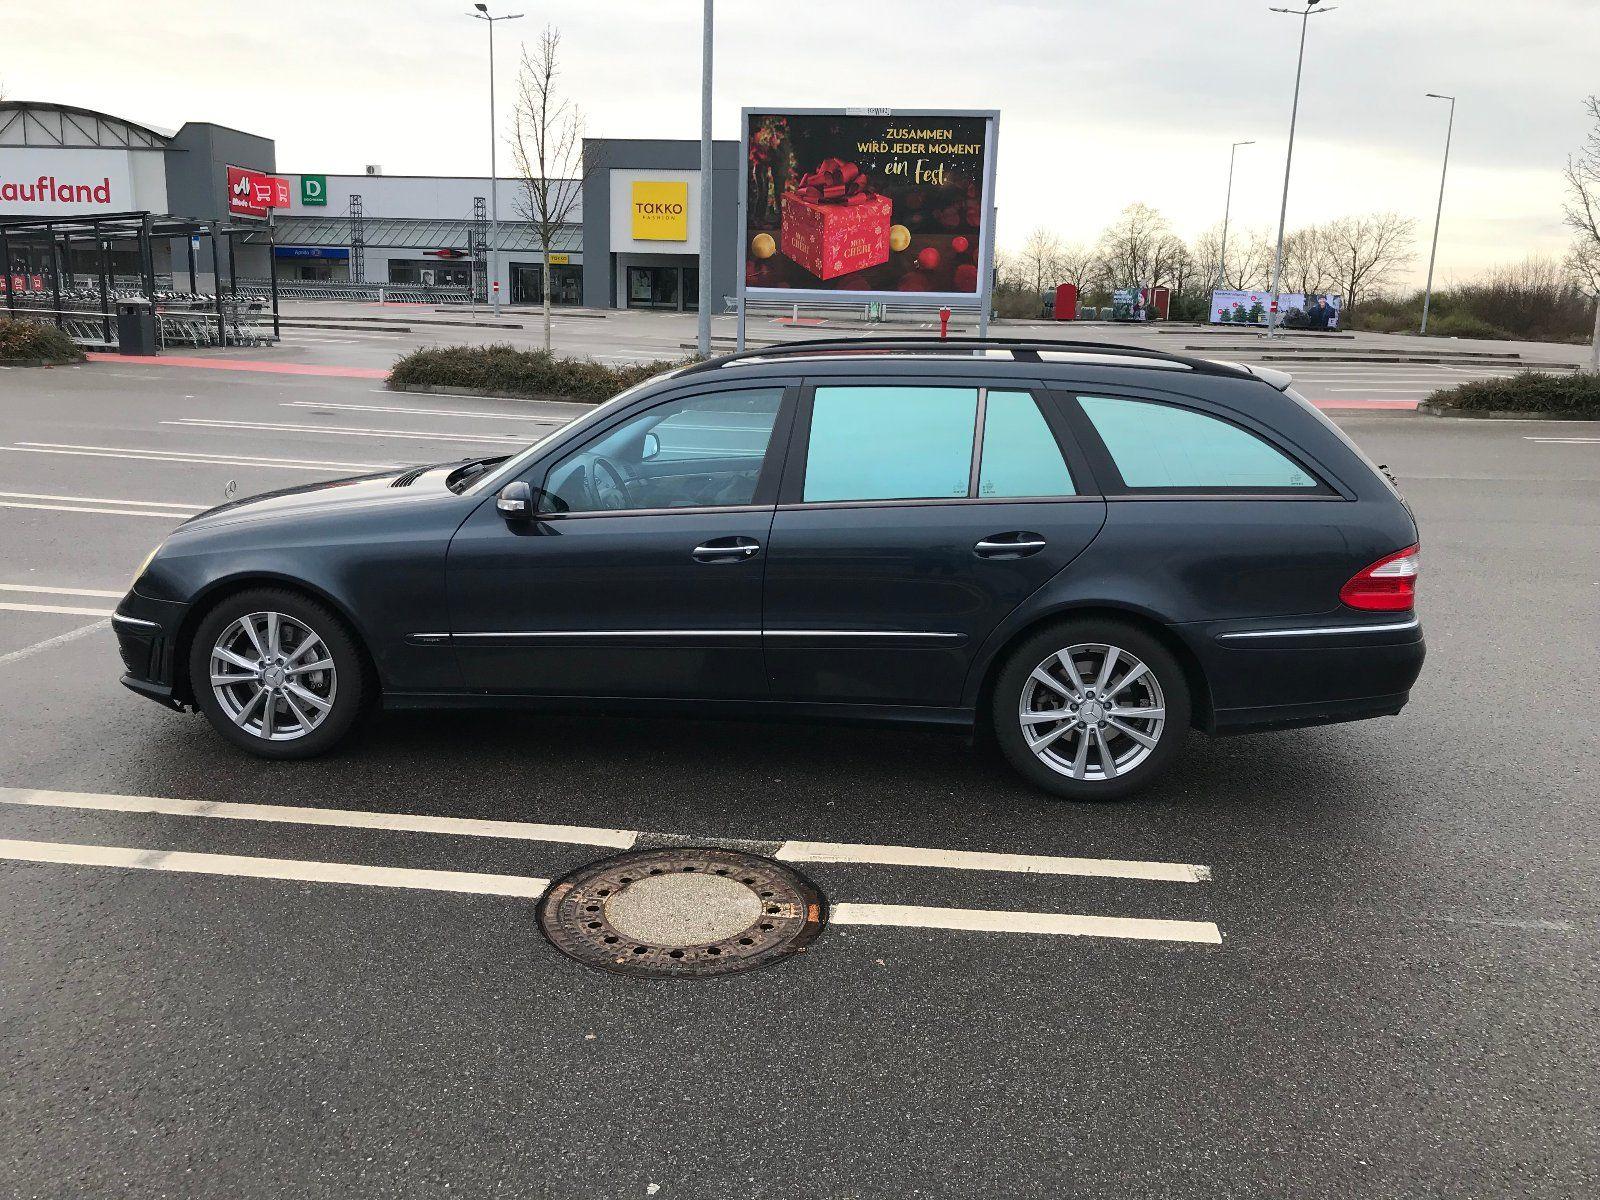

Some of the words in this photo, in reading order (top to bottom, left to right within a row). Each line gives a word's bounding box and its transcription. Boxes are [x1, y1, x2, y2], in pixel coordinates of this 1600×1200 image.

[886, 128, 953, 139] ZUSAMMEN
[857, 142, 888, 153] WIRD
[891, 143, 925, 154] JEDER
[929, 144, 981, 154] MOMENT
[885, 156, 908, 176] ein
[0, 176, 111, 203] aufland
